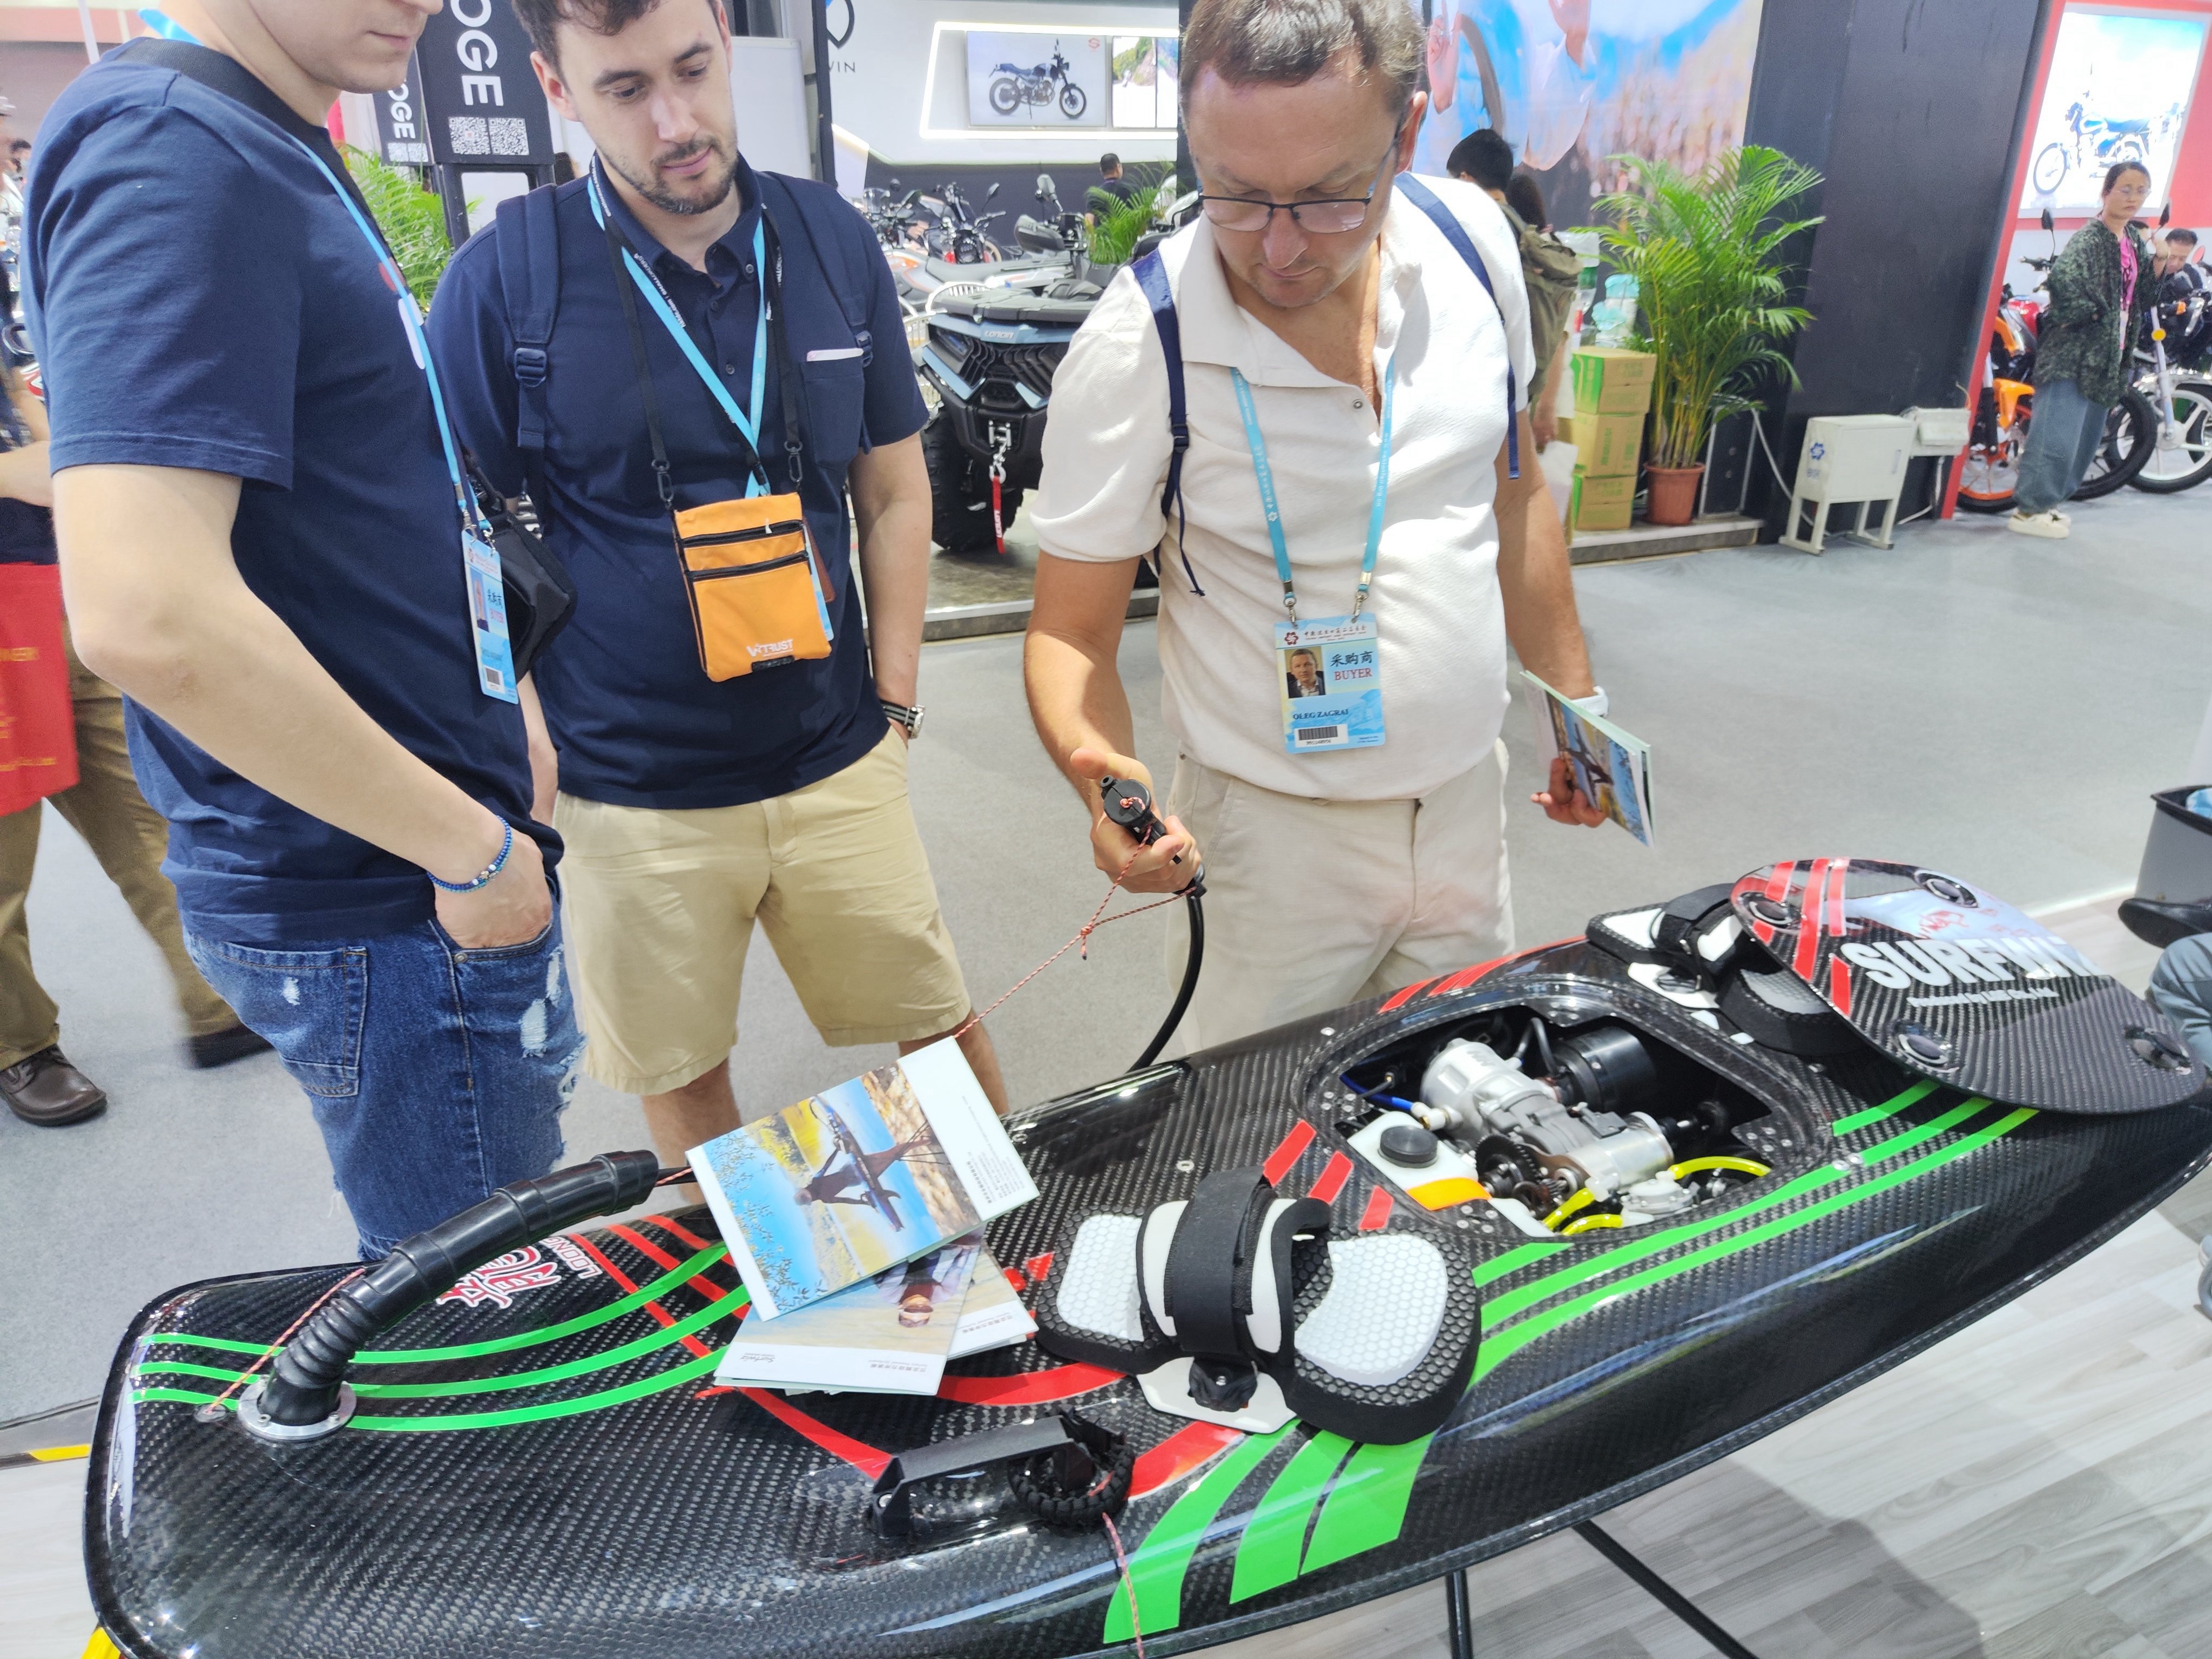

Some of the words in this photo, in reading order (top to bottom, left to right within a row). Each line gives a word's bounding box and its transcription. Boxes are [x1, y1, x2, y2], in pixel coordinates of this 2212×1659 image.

[1331, 651, 1373, 667] 采购商
[1334, 668, 1372, 680] BUYER
[1292, 712, 1317, 720] OLEG
